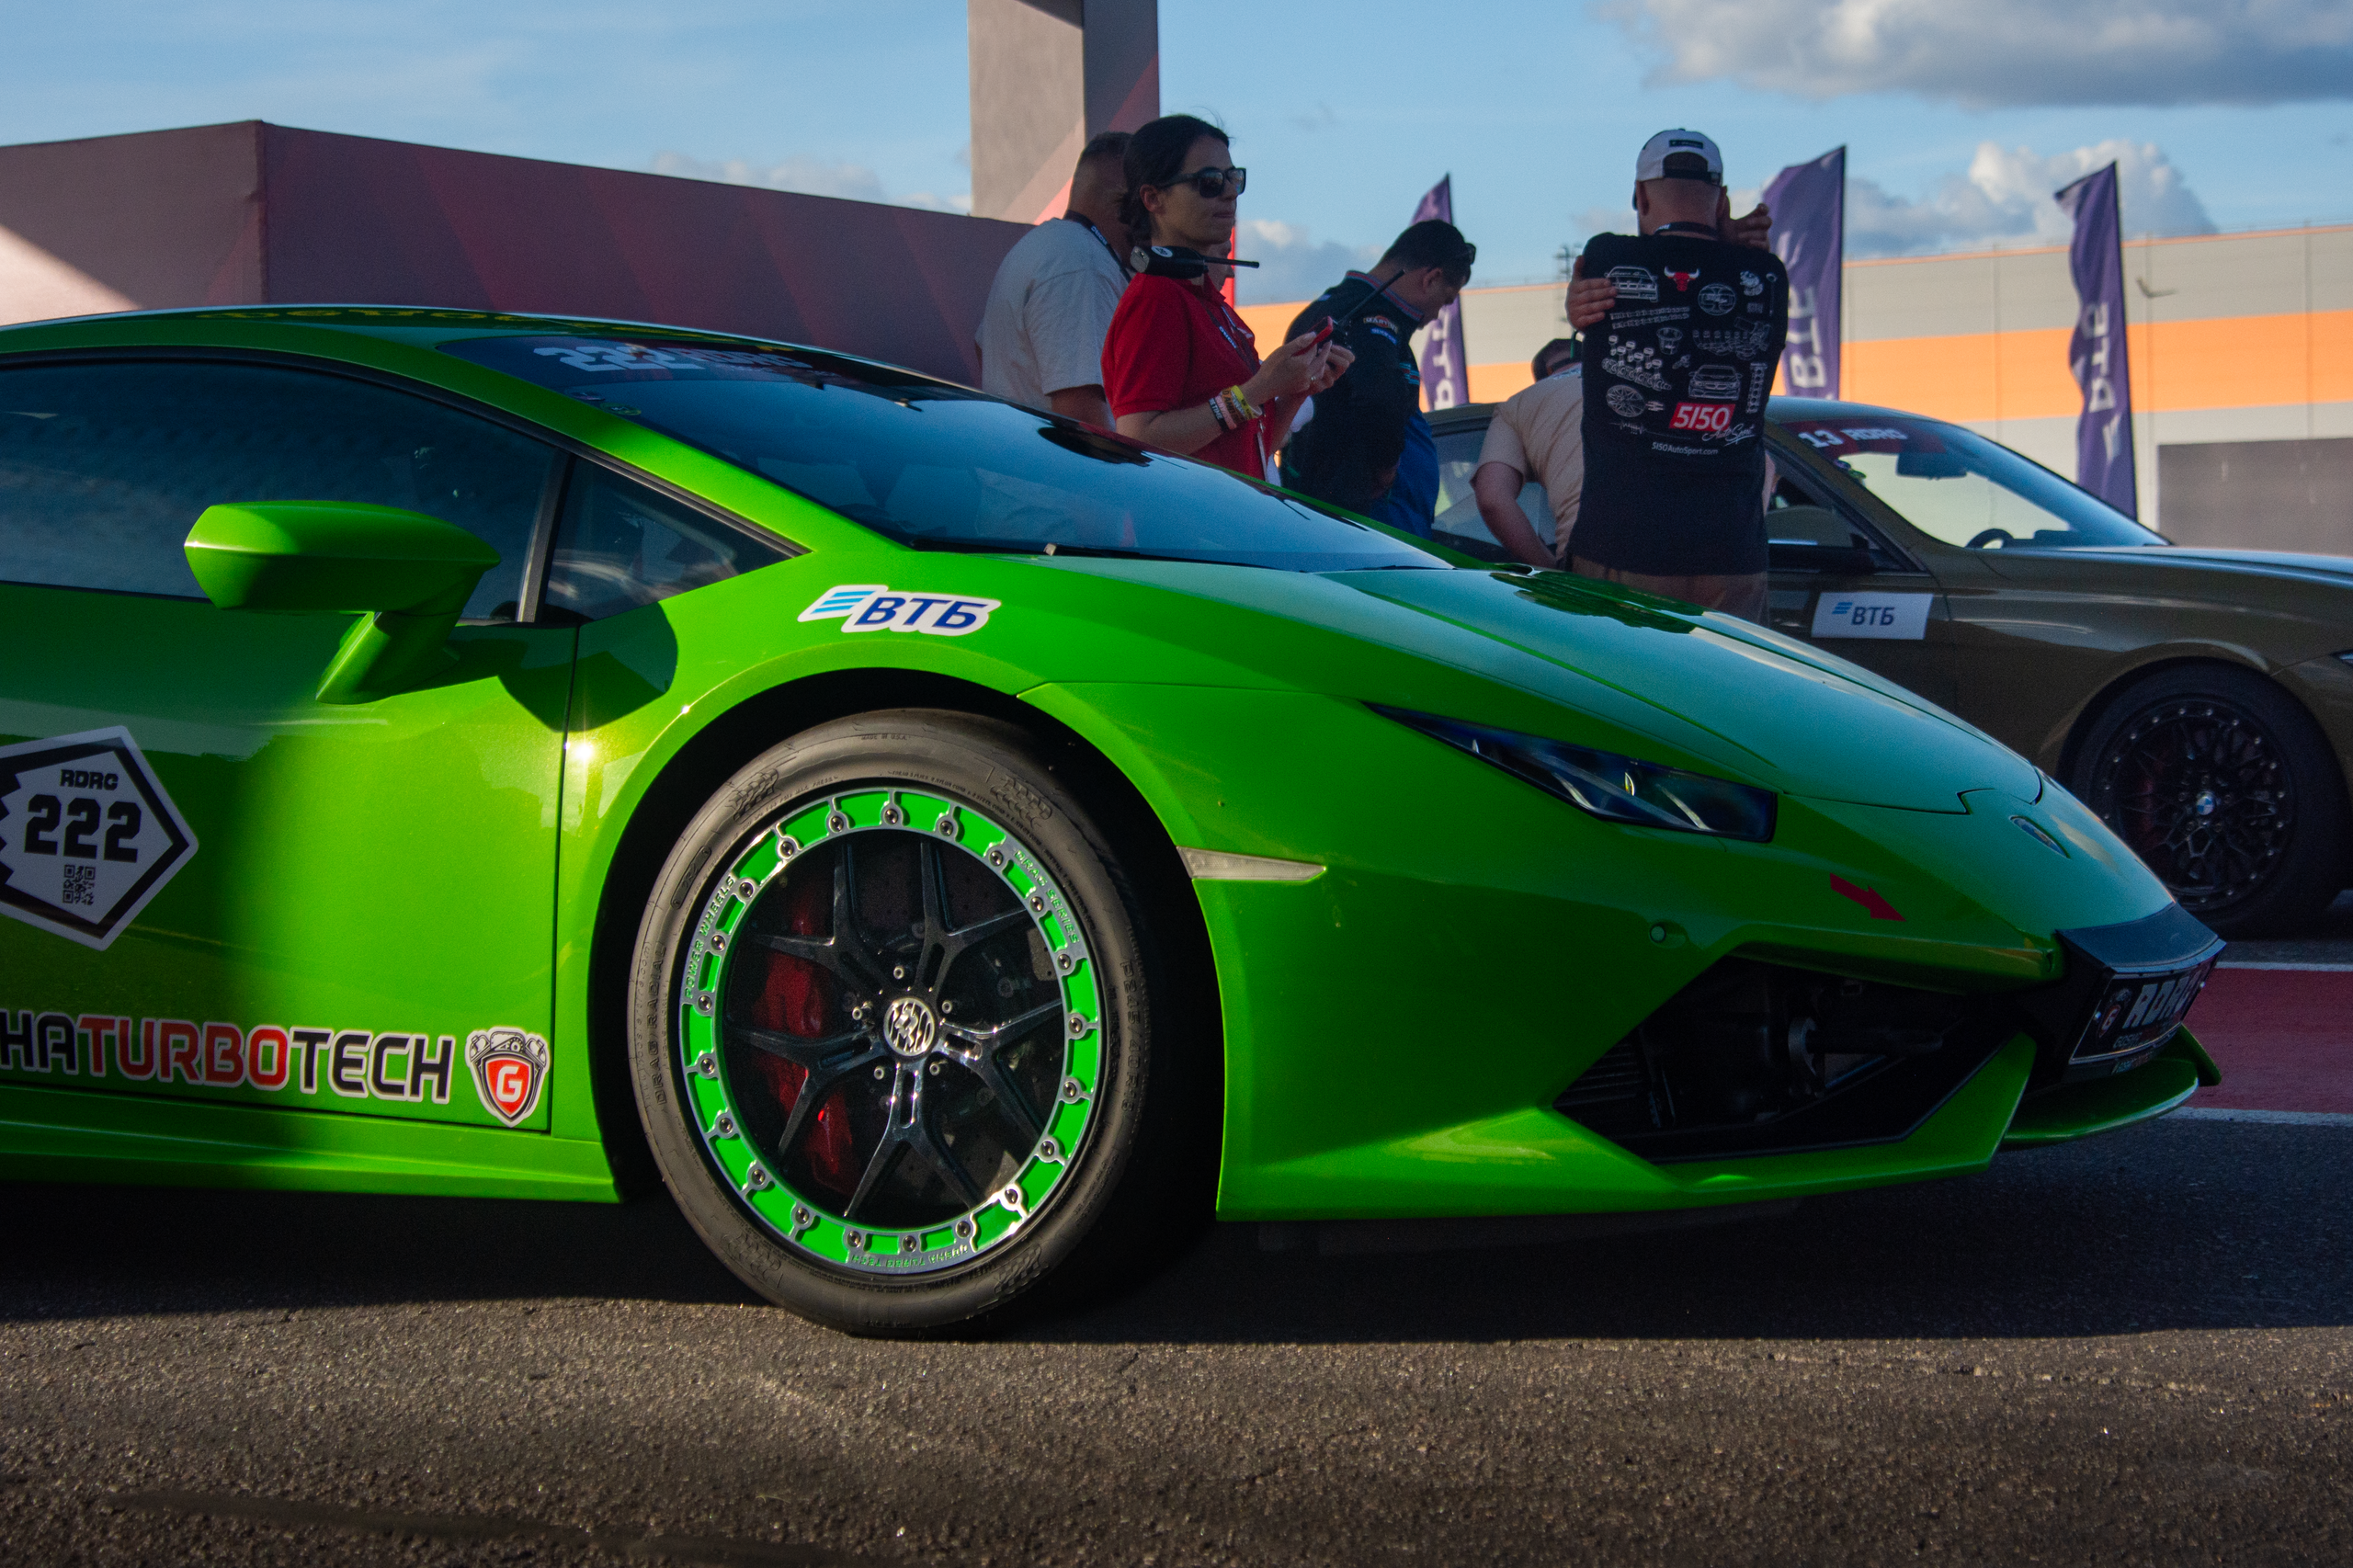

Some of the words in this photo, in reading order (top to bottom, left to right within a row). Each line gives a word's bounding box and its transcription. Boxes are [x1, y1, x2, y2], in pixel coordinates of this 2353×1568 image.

[1673, 404, 1731, 431] 5150
[853, 597, 990, 630] ВТБ
[1850, 606, 1896, 626] ВТБ
[24, 793, 142, 863] 222
[1044, 885, 1080, 946] SERIES
[682, 938, 705, 1000] POWER
[697, 879, 733, 939] WHEELS
